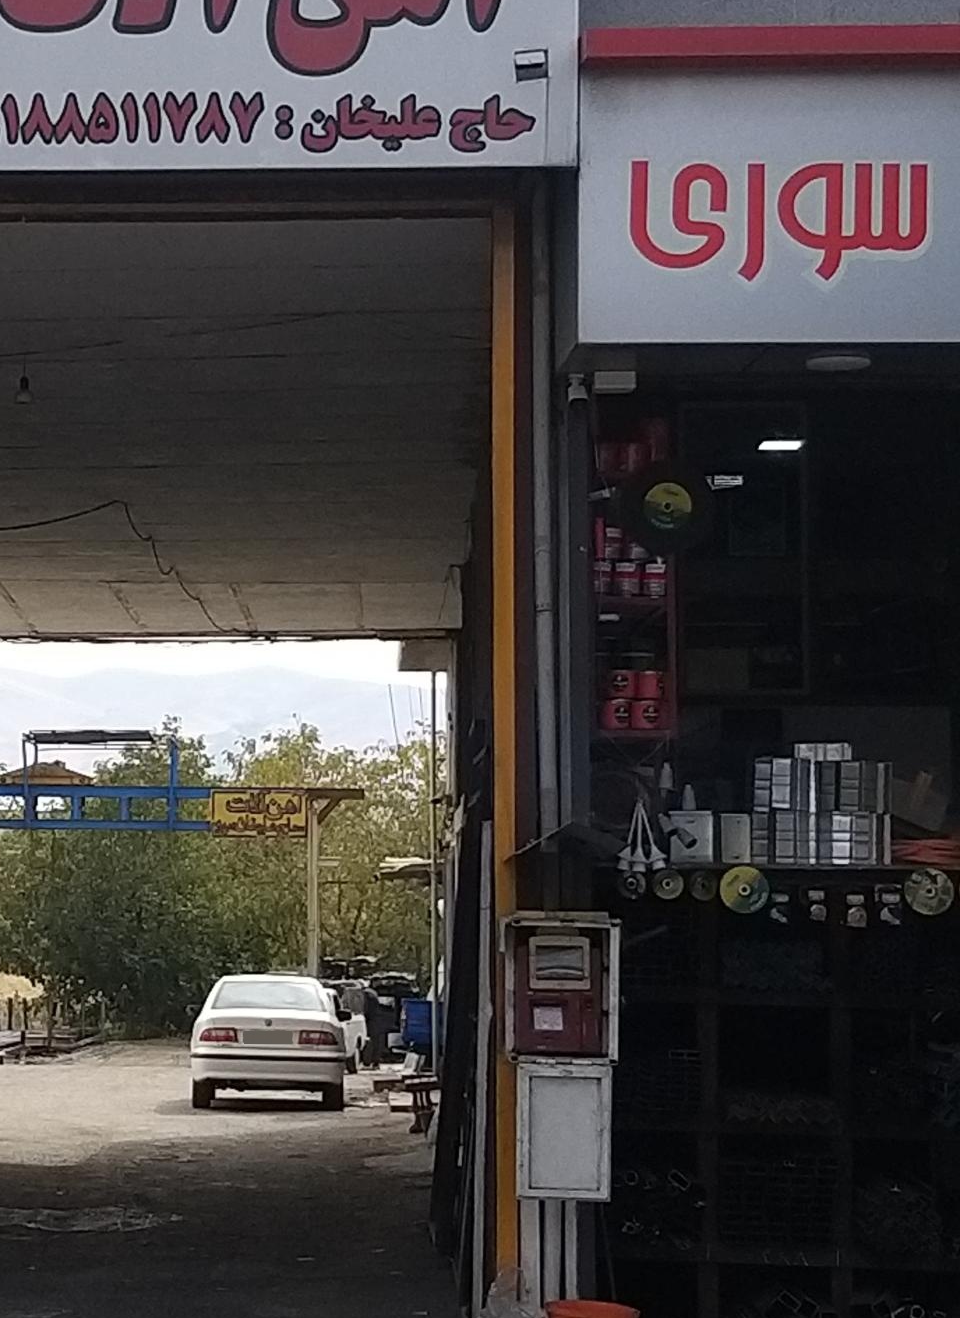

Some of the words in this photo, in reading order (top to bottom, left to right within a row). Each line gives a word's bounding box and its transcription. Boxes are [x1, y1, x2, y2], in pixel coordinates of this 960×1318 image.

[301, 94, 441, 153] علیخان
[449, 94, 536, 153] حاج
[630, 159, 928, 282] سوری
